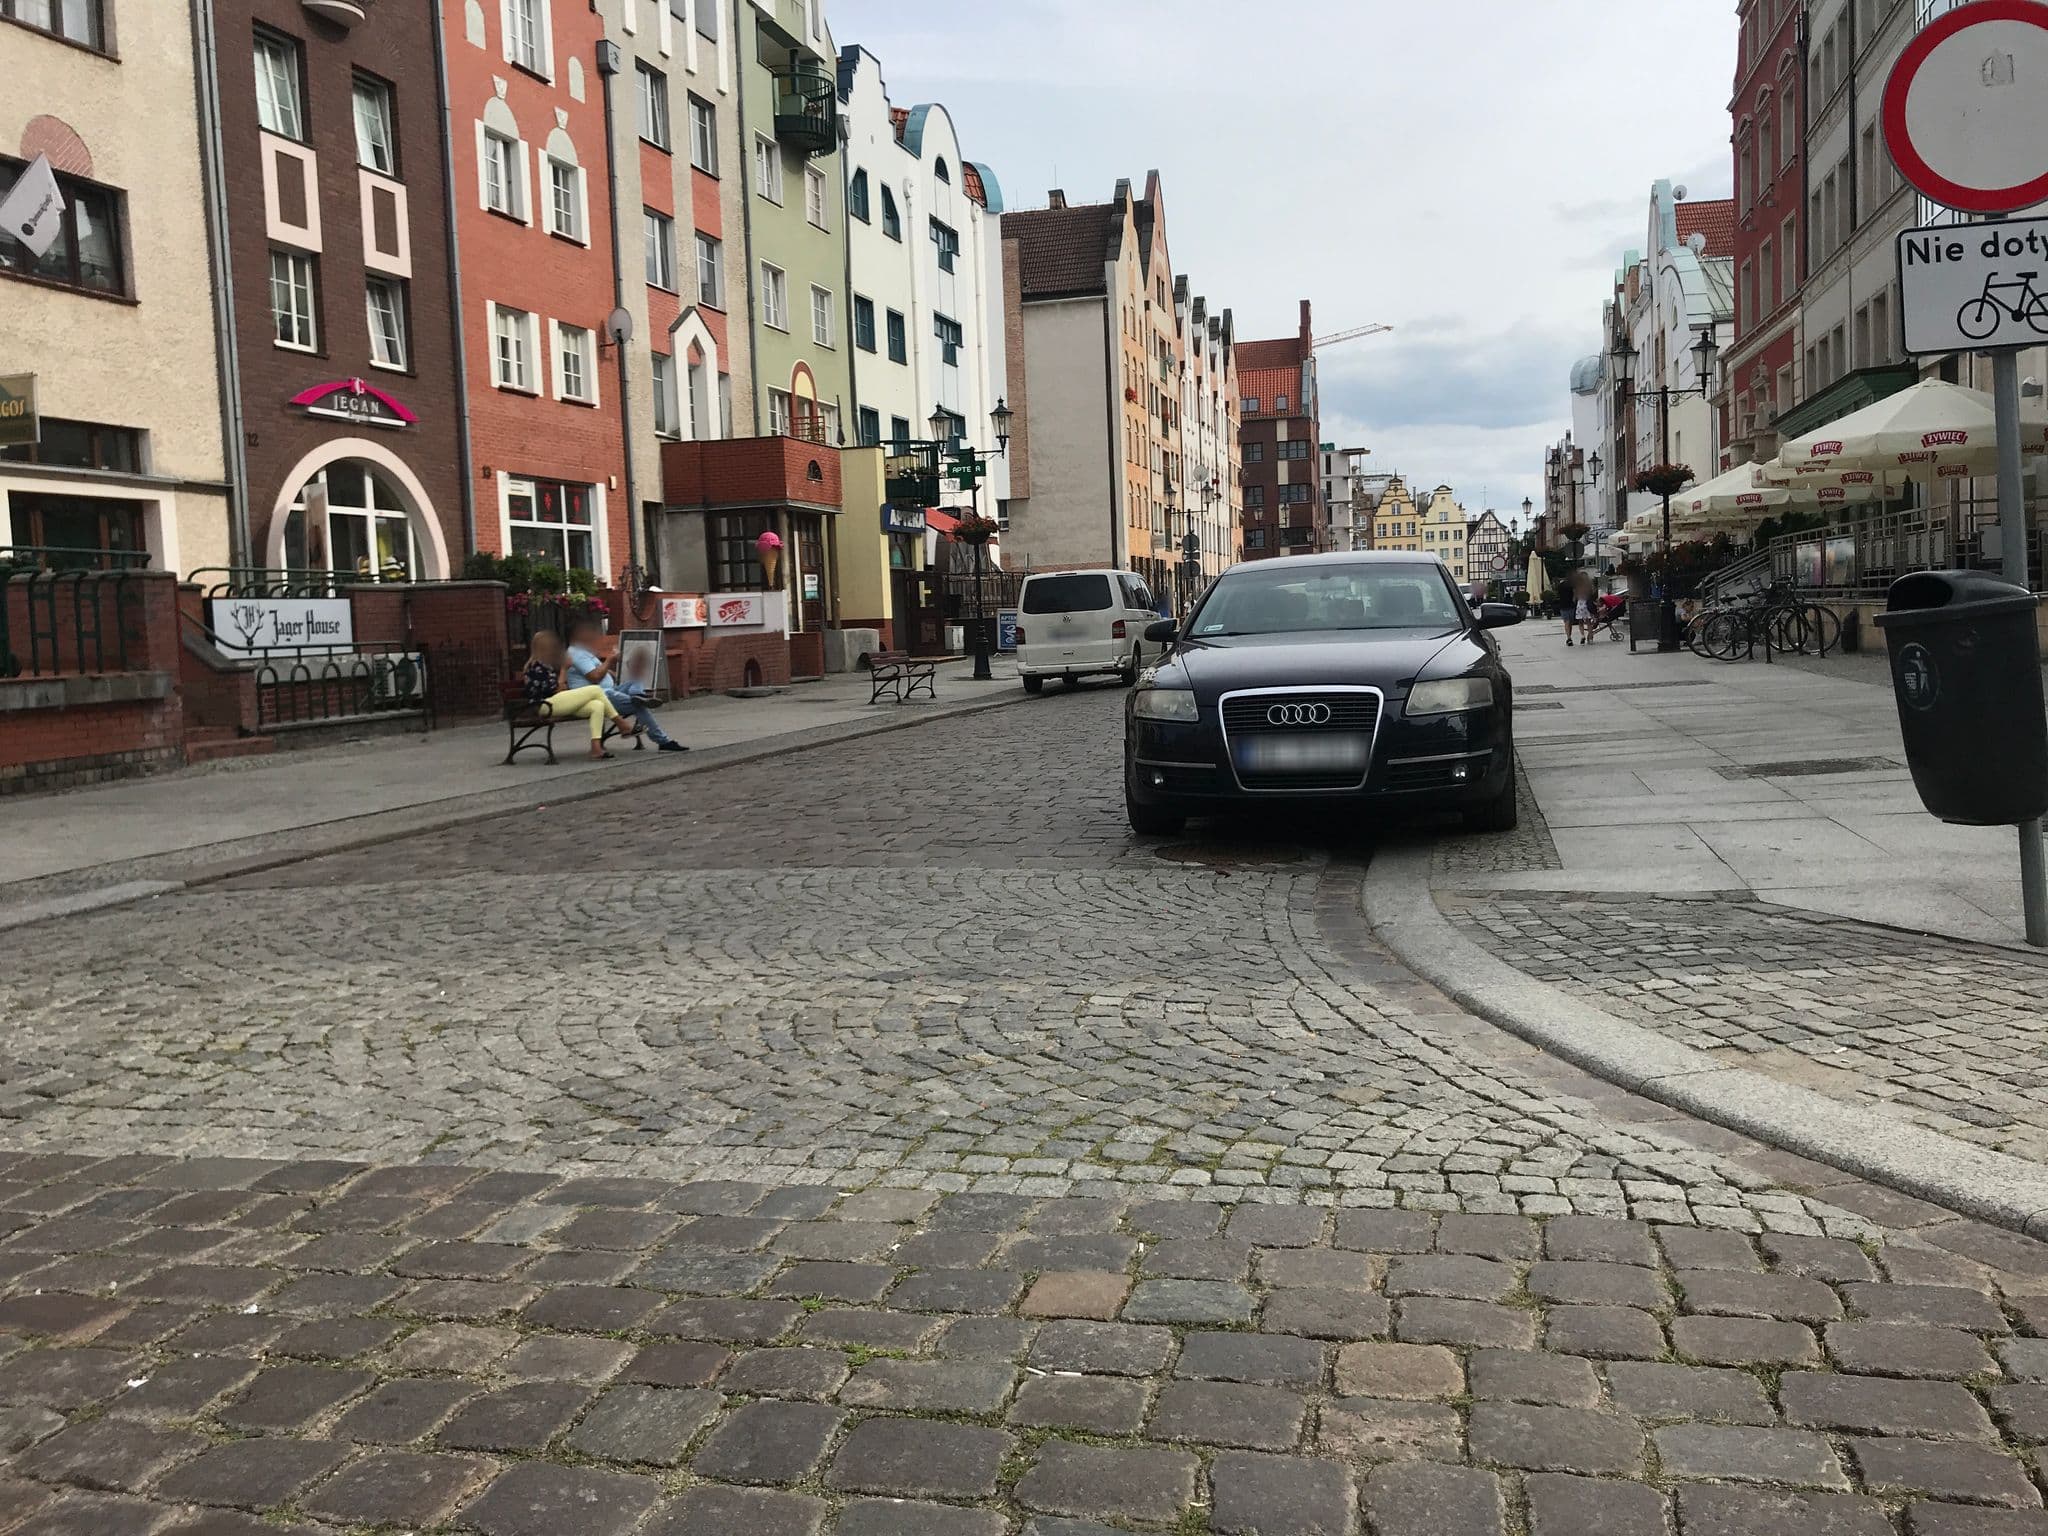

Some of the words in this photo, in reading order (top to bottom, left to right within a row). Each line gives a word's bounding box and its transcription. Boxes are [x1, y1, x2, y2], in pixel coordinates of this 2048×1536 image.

[1907, 237, 1964, 265] Nie
[332, 395, 380, 414] JEGAN
[246, 432, 259, 447] 12
[952, 465, 981, 474] APTEA
[890, 509, 925, 529] APTEKA
[306, 609, 340, 642] House
